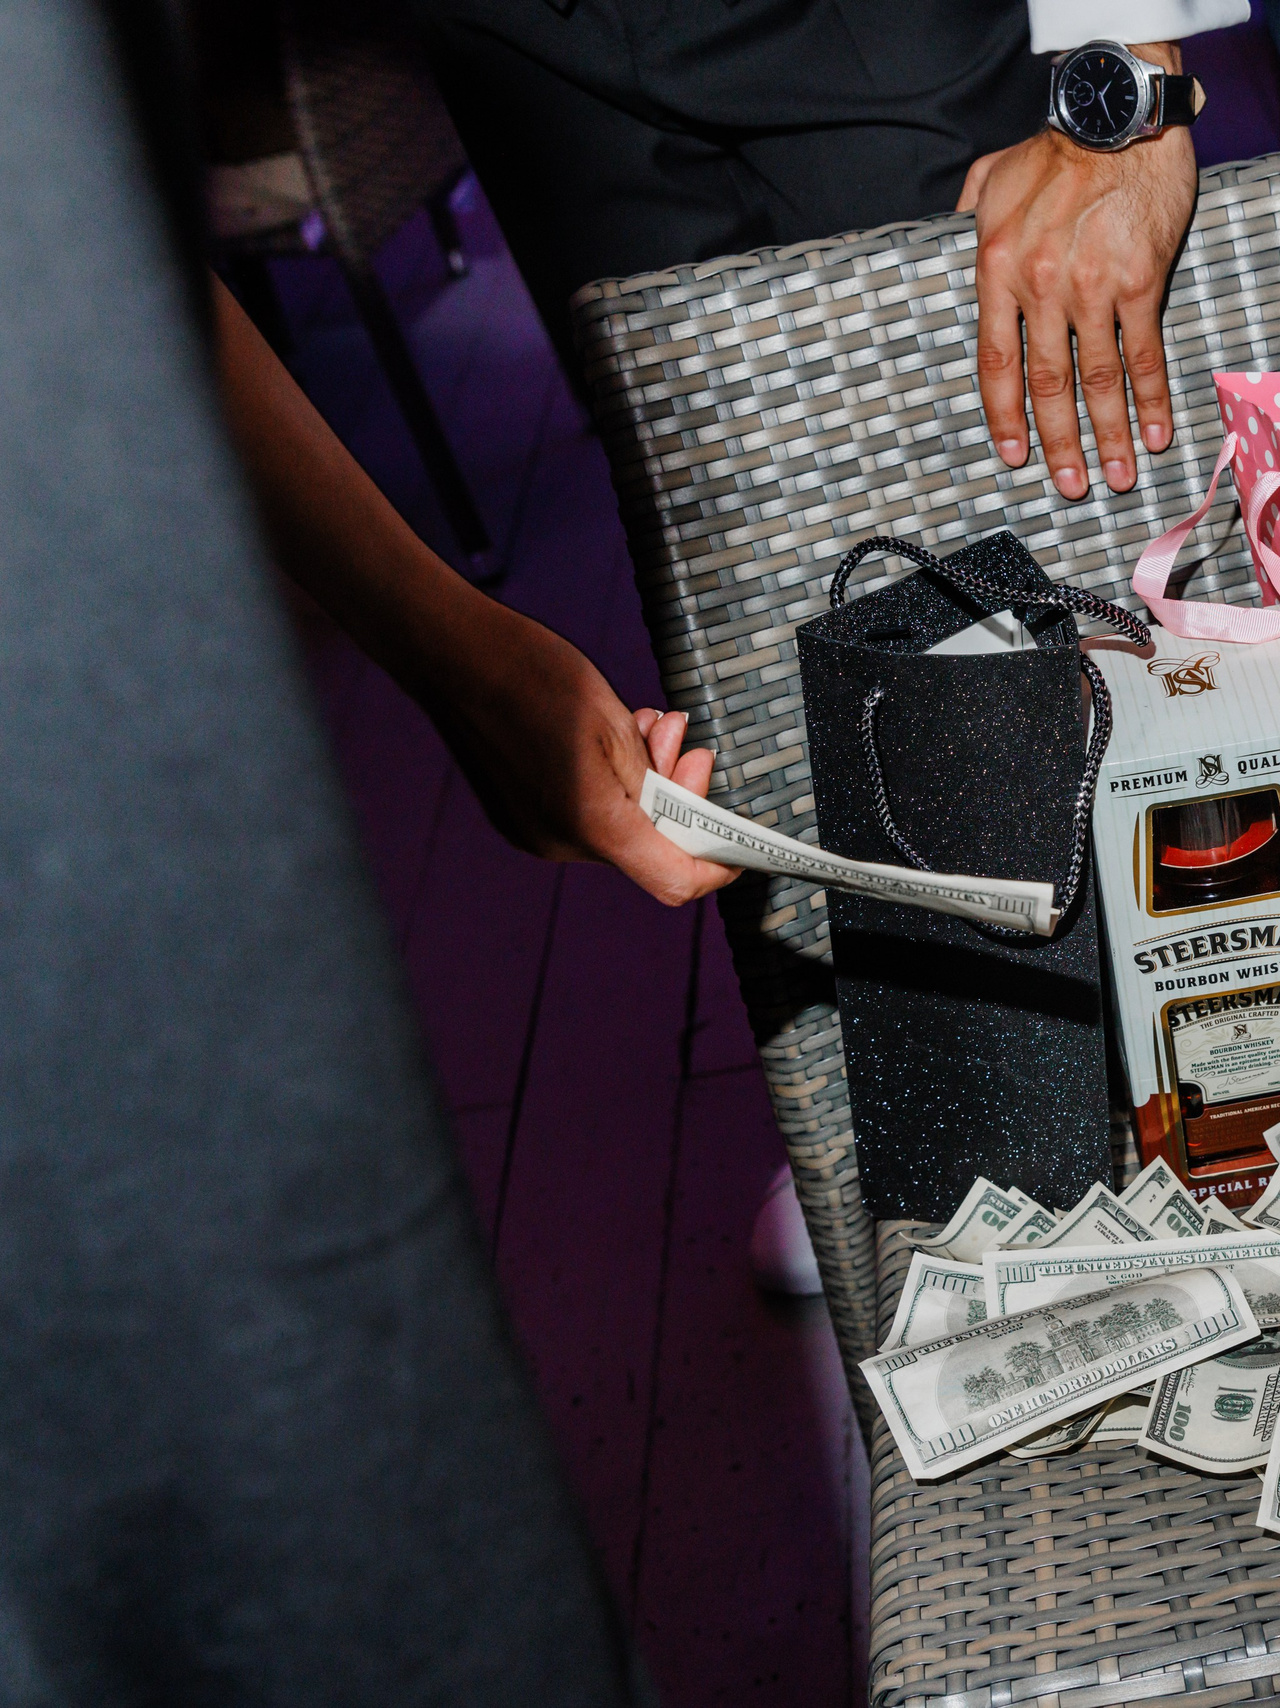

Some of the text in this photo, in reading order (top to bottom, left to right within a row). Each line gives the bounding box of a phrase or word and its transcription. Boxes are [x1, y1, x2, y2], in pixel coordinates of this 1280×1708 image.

[1110, 770, 1188, 793] PREMIUM
[1155, 971, 1230, 992] BOURBON
[1200, 1010, 1279, 1030] THE ORIGINAL CRAFTED
[1209, 1039, 1275, 1056] BOURBON WHISKEY
[1247, 1051, 1267, 1061] quality
[1190, 1064, 1225, 1074] STEERSMAN
[1228, 1065, 1248, 1074] quality
[1210, 1110, 1243, 1120] TRADITIONAL
[1244, 1104, 1270, 1114] AMERICAN
[1189, 1180, 1253, 1199] SPECIAL
[1038, 1263, 1072, 1276] THE
[1072, 1259, 1132, 1274] UNITED
[1133, 1253, 1196, 1268] STATES
[1197, 1251, 1214, 1263] OF
[997, 1264, 1035, 1284] 100
[1120, 1272, 1143, 1280] GOD
[1186, 1308, 1239, 1342] 100
[986, 1335, 1179, 1430] ONE HUNDRED DOLLARS
[1152, 1396, 1170, 1436] DOLLARS
[1167, 1400, 1193, 1442] 100
[1252, 1385, 1274, 1438] AMERICA
[915, 1422, 978, 1463] 100
